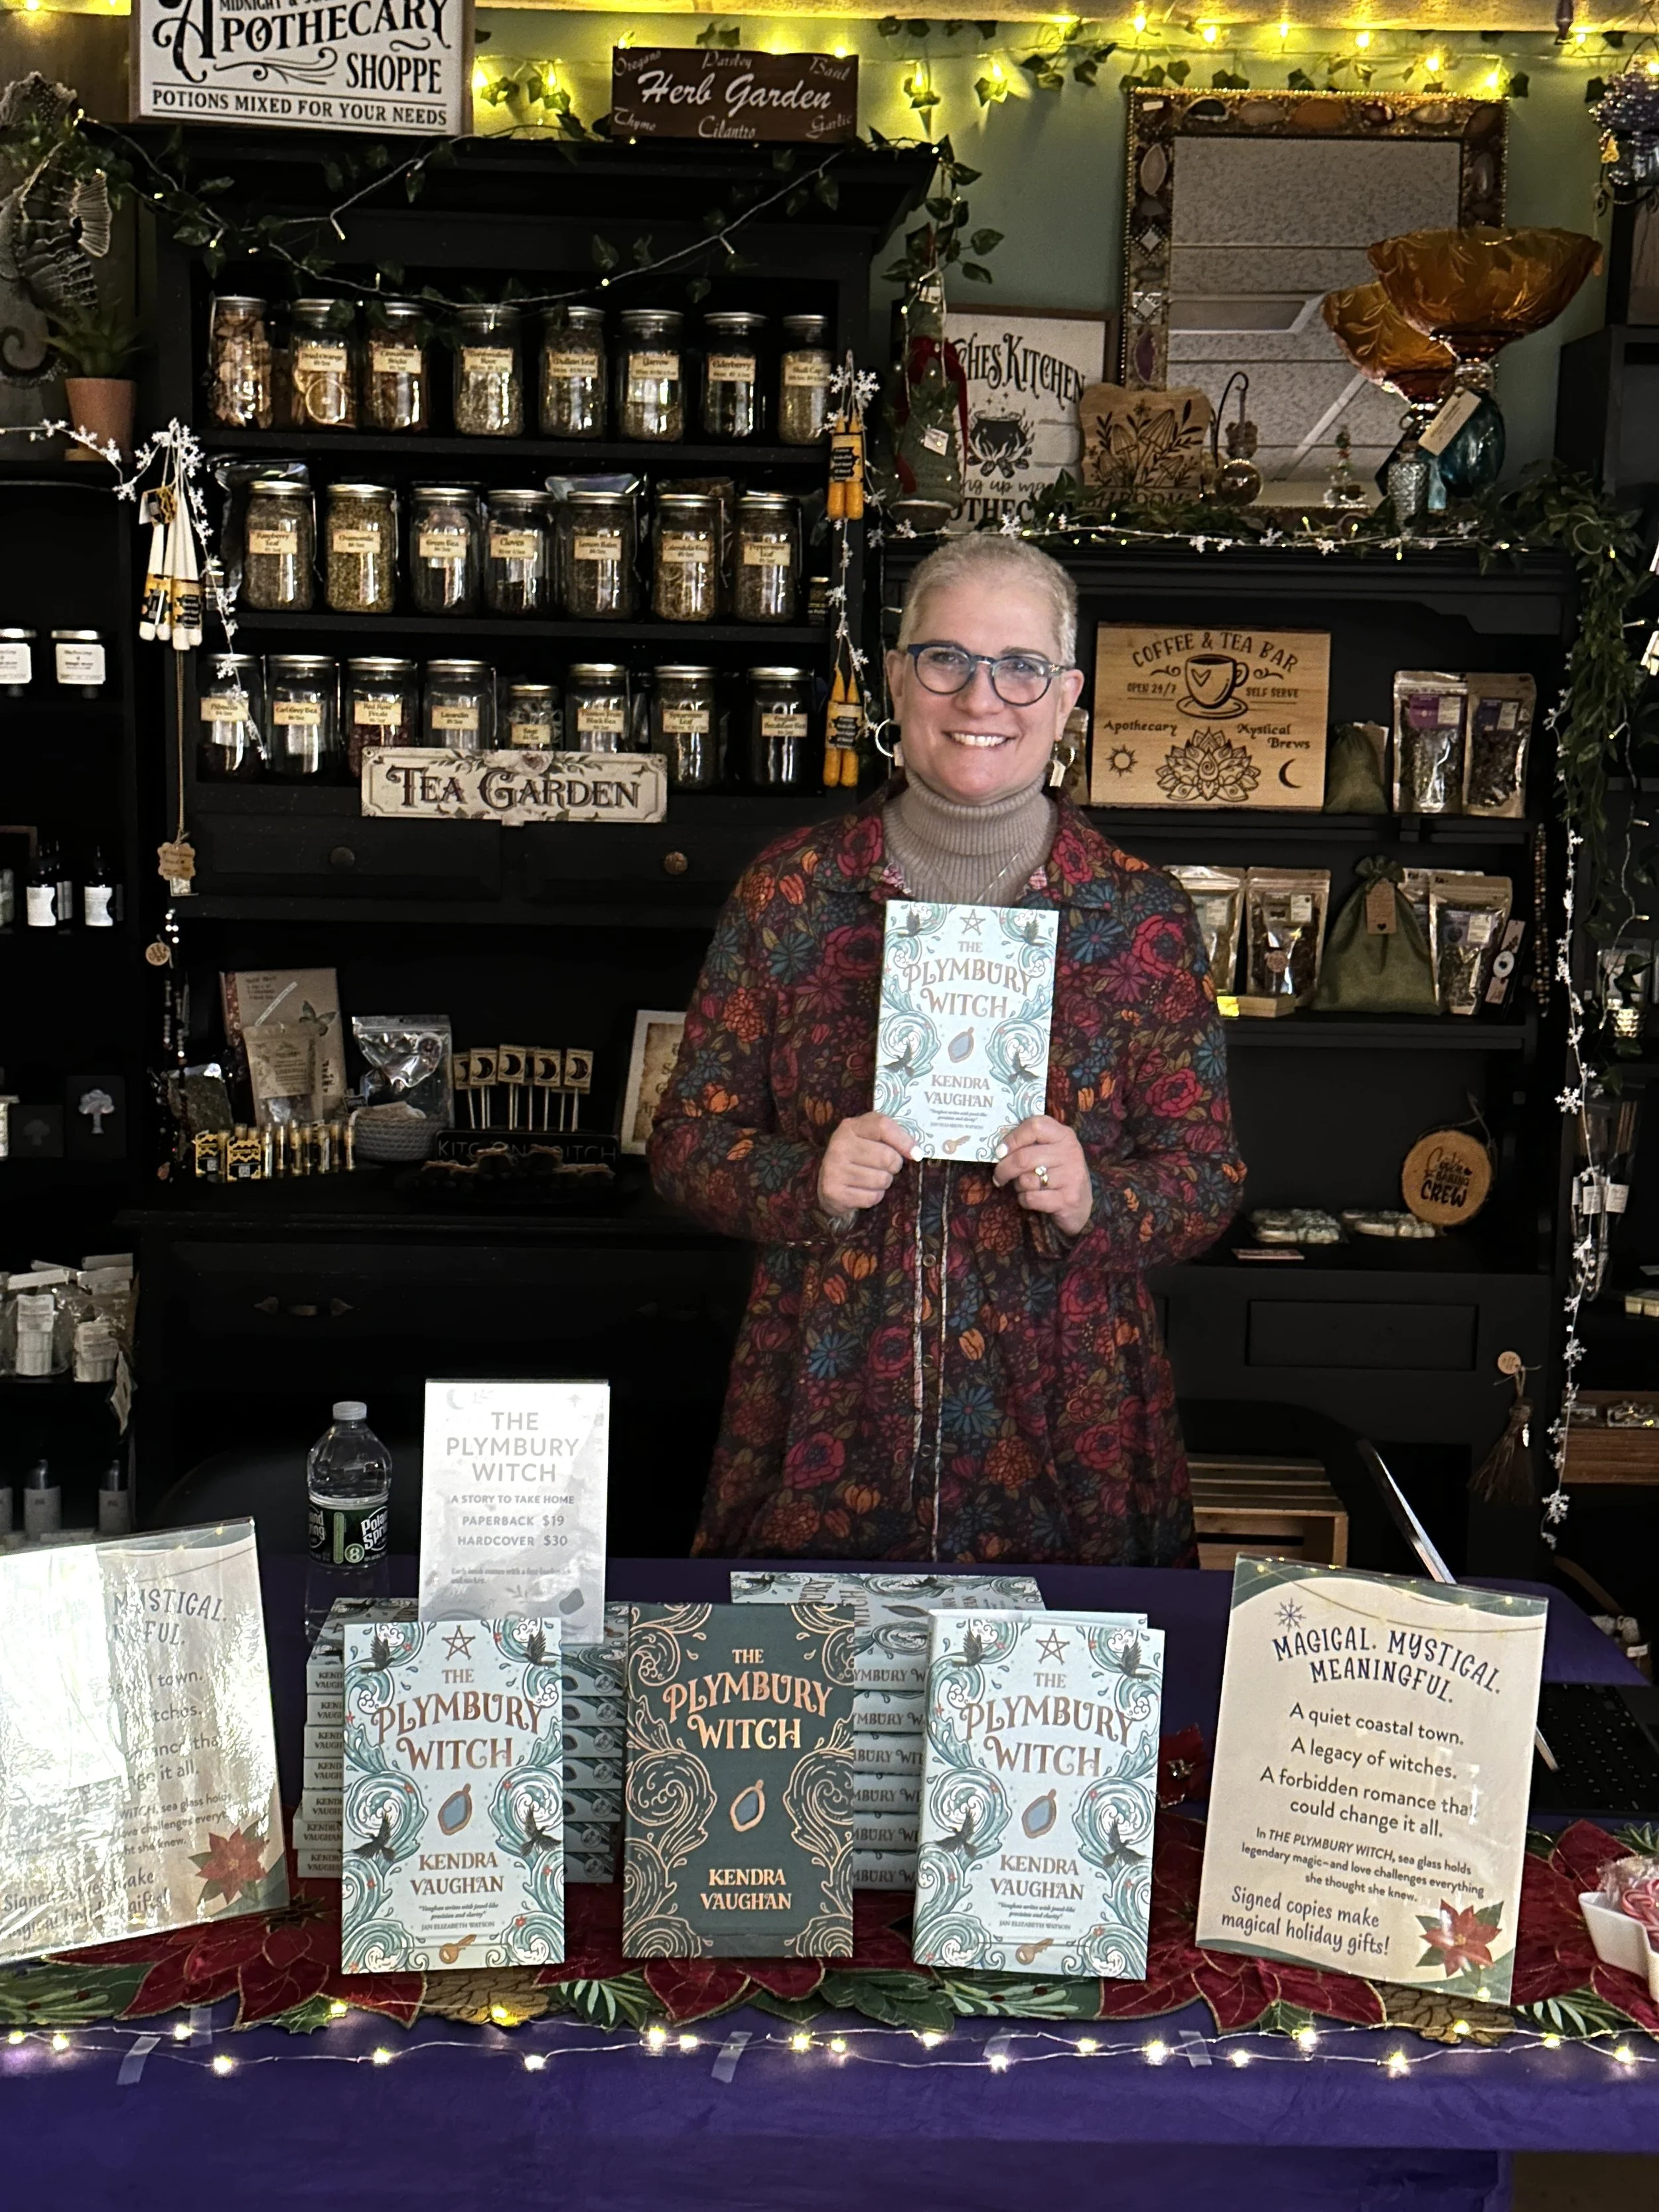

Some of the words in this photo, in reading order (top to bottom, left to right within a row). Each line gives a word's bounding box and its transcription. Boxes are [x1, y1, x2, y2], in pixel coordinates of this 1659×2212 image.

[152, 0, 452, 83] APOTHECARY
[346, 52, 442, 94] SHOPPE
[614, 50, 662, 76] Oregano
[701, 50, 753, 70] Parsley
[637, 70, 716, 105] Herb
[725, 73, 831, 117] Garden
[153, 90, 229, 110] POTIONS
[235, 95, 291, 113] MIXED
[298, 100, 332, 117] FOR
[339, 103, 386, 121] YOUR
[393, 108, 447, 125] NEEDS
[613, 107, 656, 131] Thyme
[698, 115, 757, 139] Cilantro
[805, 113, 853, 139] Garlic
[1003, 332, 1086, 411] KITCHEN
[1132, 632, 1194, 668] COFFEE
[1201, 631, 1214, 650] &
[1220, 632, 1252, 653] TEA
[1259, 640, 1299, 673] BAR
[1127, 682, 1149, 694] OPEN
[1151, 682, 1177, 697] 24/7
[1246, 686, 1267, 697] SELF
[1270, 688, 1299, 698] SERVE
[1104, 720, 1178, 737] Apothecary
[1236, 723, 1291, 739] Mystical
[1267, 737, 1311, 750] Brews
[386, 764, 465, 806] TEA
[477, 767, 642, 811] GARDEN
[958, 941, 983, 953] THE
[902, 957, 1039, 997] PLYMBURY
[920, 988, 1008, 1018] WITCH
[931, 1074, 990, 1090] KENDRA
[924, 1091, 995, 1108] VAUGHAN
[1421, 1179, 1467, 1208] CREW
[492, 1412, 539, 1431] THE
[446, 1437, 579, 1457] PLYMBURY
[472, 1463, 556, 1482] WITCH
[451, 1495, 460, 1504] A
[461, 1495, 495, 1504] STORY
[498, 1495, 512, 1505] TO
[514, 1495, 541, 1505] TAKE
[543, 1495, 575, 1505] HOME
[360, 1508, 388, 1536] Polan
[462, 1515, 534, 1526] PAPERBACK
[542, 1514, 565, 1527] $19
[457, 1535, 534, 1547] HARDCOVER
[543, 1535, 567, 1547] $30
[732, 1649, 764, 1664] THE
[1271, 1626, 1377, 1662] MAGICAL.
[1387, 1630, 1501, 1694] MYSTICAL.
[157, 1670, 203, 1690] town.
[442, 1668, 474, 1684] THE
[853, 1668, 908, 1682] YMBURY
[1033, 1671, 1067, 1689] THE
[1309, 1657, 1453, 1704] MEANINGFUL.
[662, 1670, 833, 1723] PLYMBURY
[370, 1690, 546, 1745] PLYMBURY
[960, 1694, 1134, 1747] PLYMBURY
[1289, 1702, 1305, 1720] A
[1308, 1708, 1351, 1726] quiet
[1356, 1718, 1413, 1737] coastal
[1418, 1726, 1465, 1745] town.
[687, 1714, 802, 1750] WITCH
[396, 1737, 514, 1771] WITCH
[983, 1735, 1102, 1777] WITCH
[1290, 1736, 1306, 1754] A
[1310, 1738, 1362, 1769] legacy
[1366, 1749, 1386, 1766] of
[1390, 1754, 1457, 1780] witches.
[160, 1764, 173, 1782] it
[177, 1760, 199, 1778] all.
[1260, 1765, 1275, 1784] A
[1279, 1768, 1358, 1798] forbidden
[1364, 1787, 1437, 1812] romance
[161, 1803, 178, 1812] sea
[180, 1797, 204, 1812] glass
[1290, 1798, 1335, 1818] could
[1339, 1805, 1398, 1834] change
[1403, 1814, 1415, 1832] it
[1419, 1818, 1444, 1838] all.
[159, 1837, 187, 1849] knew.
[1256, 1827, 1266, 1840] In
[1269, 1828, 1290, 1844] THE
[1293, 1834, 1354, 1854] PLYMBURY
[1356, 1844, 1396, 1864] WITCH,
[1398, 1854, 1415, 1866] sea
[1417, 1856, 1441, 1872] glass
[1443, 1858, 1472, 1876] holds
[419, 1852, 499, 1872] KENDRA
[999, 1854, 1080, 1876] KENDRA
[1242, 1842, 1290, 1864] legendary
[1351, 1860, 1372, 1875] love
[1374, 1864, 1427, 1887] challenges
[1429, 1876, 1484, 1899] everything
[409, 1875, 504, 1895] VAUGHAN
[709, 1868, 786, 1885] KENDRA
[989, 1878, 1084, 1901] VAUGHAN
[1305, 1872, 1323, 1885] she
[1325, 1876, 1365, 1895] thought
[1368, 1882, 1386, 1895] she
[1388, 1887, 1418, 1902] knew.
[700, 1892, 792, 1910] VAUGHAN
[1231, 1885, 1281, 1911] Signed
[1286, 1899, 1332, 1922] copies
[1337, 1907, 1380, 1929] make
[1221, 1913, 1280, 1937] magical
[1286, 1920, 1343, 1953] holiday
[1347, 1932, 1390, 1956] gifts!
